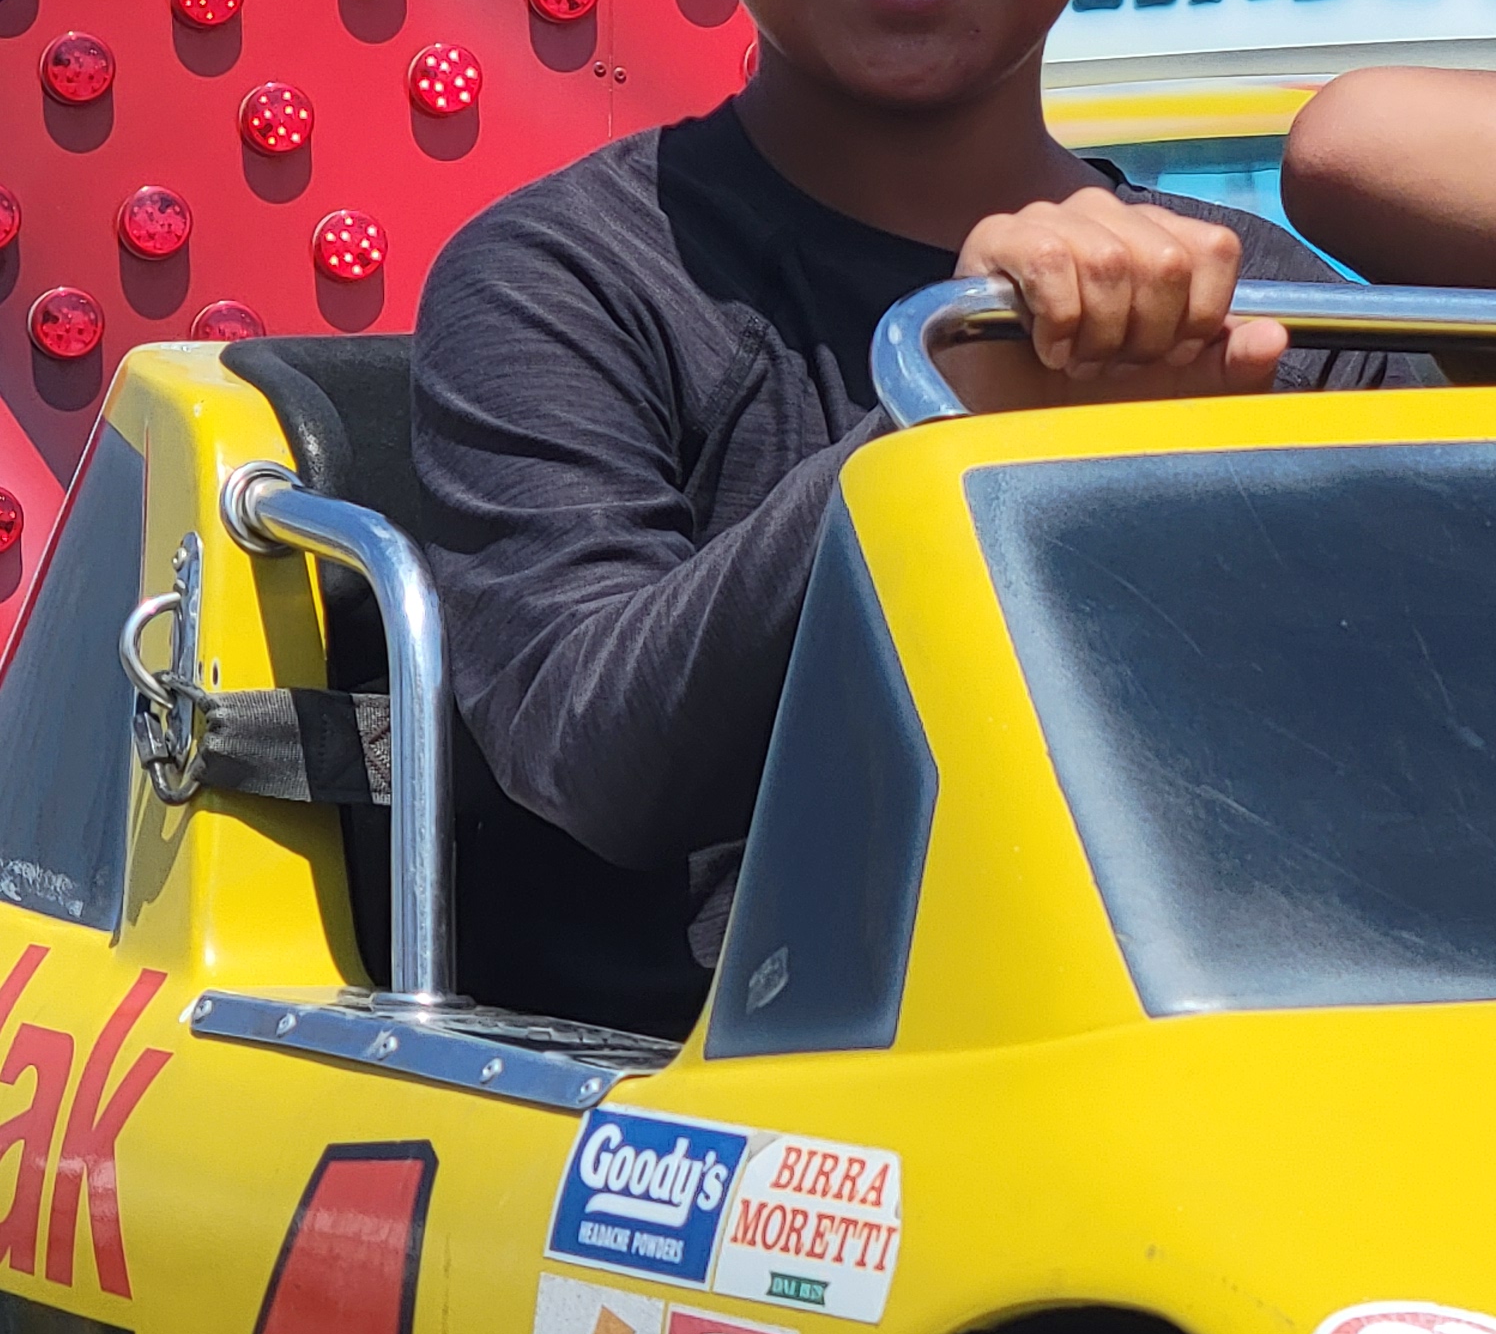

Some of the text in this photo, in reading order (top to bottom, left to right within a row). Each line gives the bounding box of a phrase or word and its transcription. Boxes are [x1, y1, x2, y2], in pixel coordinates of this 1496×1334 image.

[578, 1122, 728, 1227] Goody's
[769, 1145, 891, 1208] BIRRA
[730, 1198, 899, 1272] MORETTI
